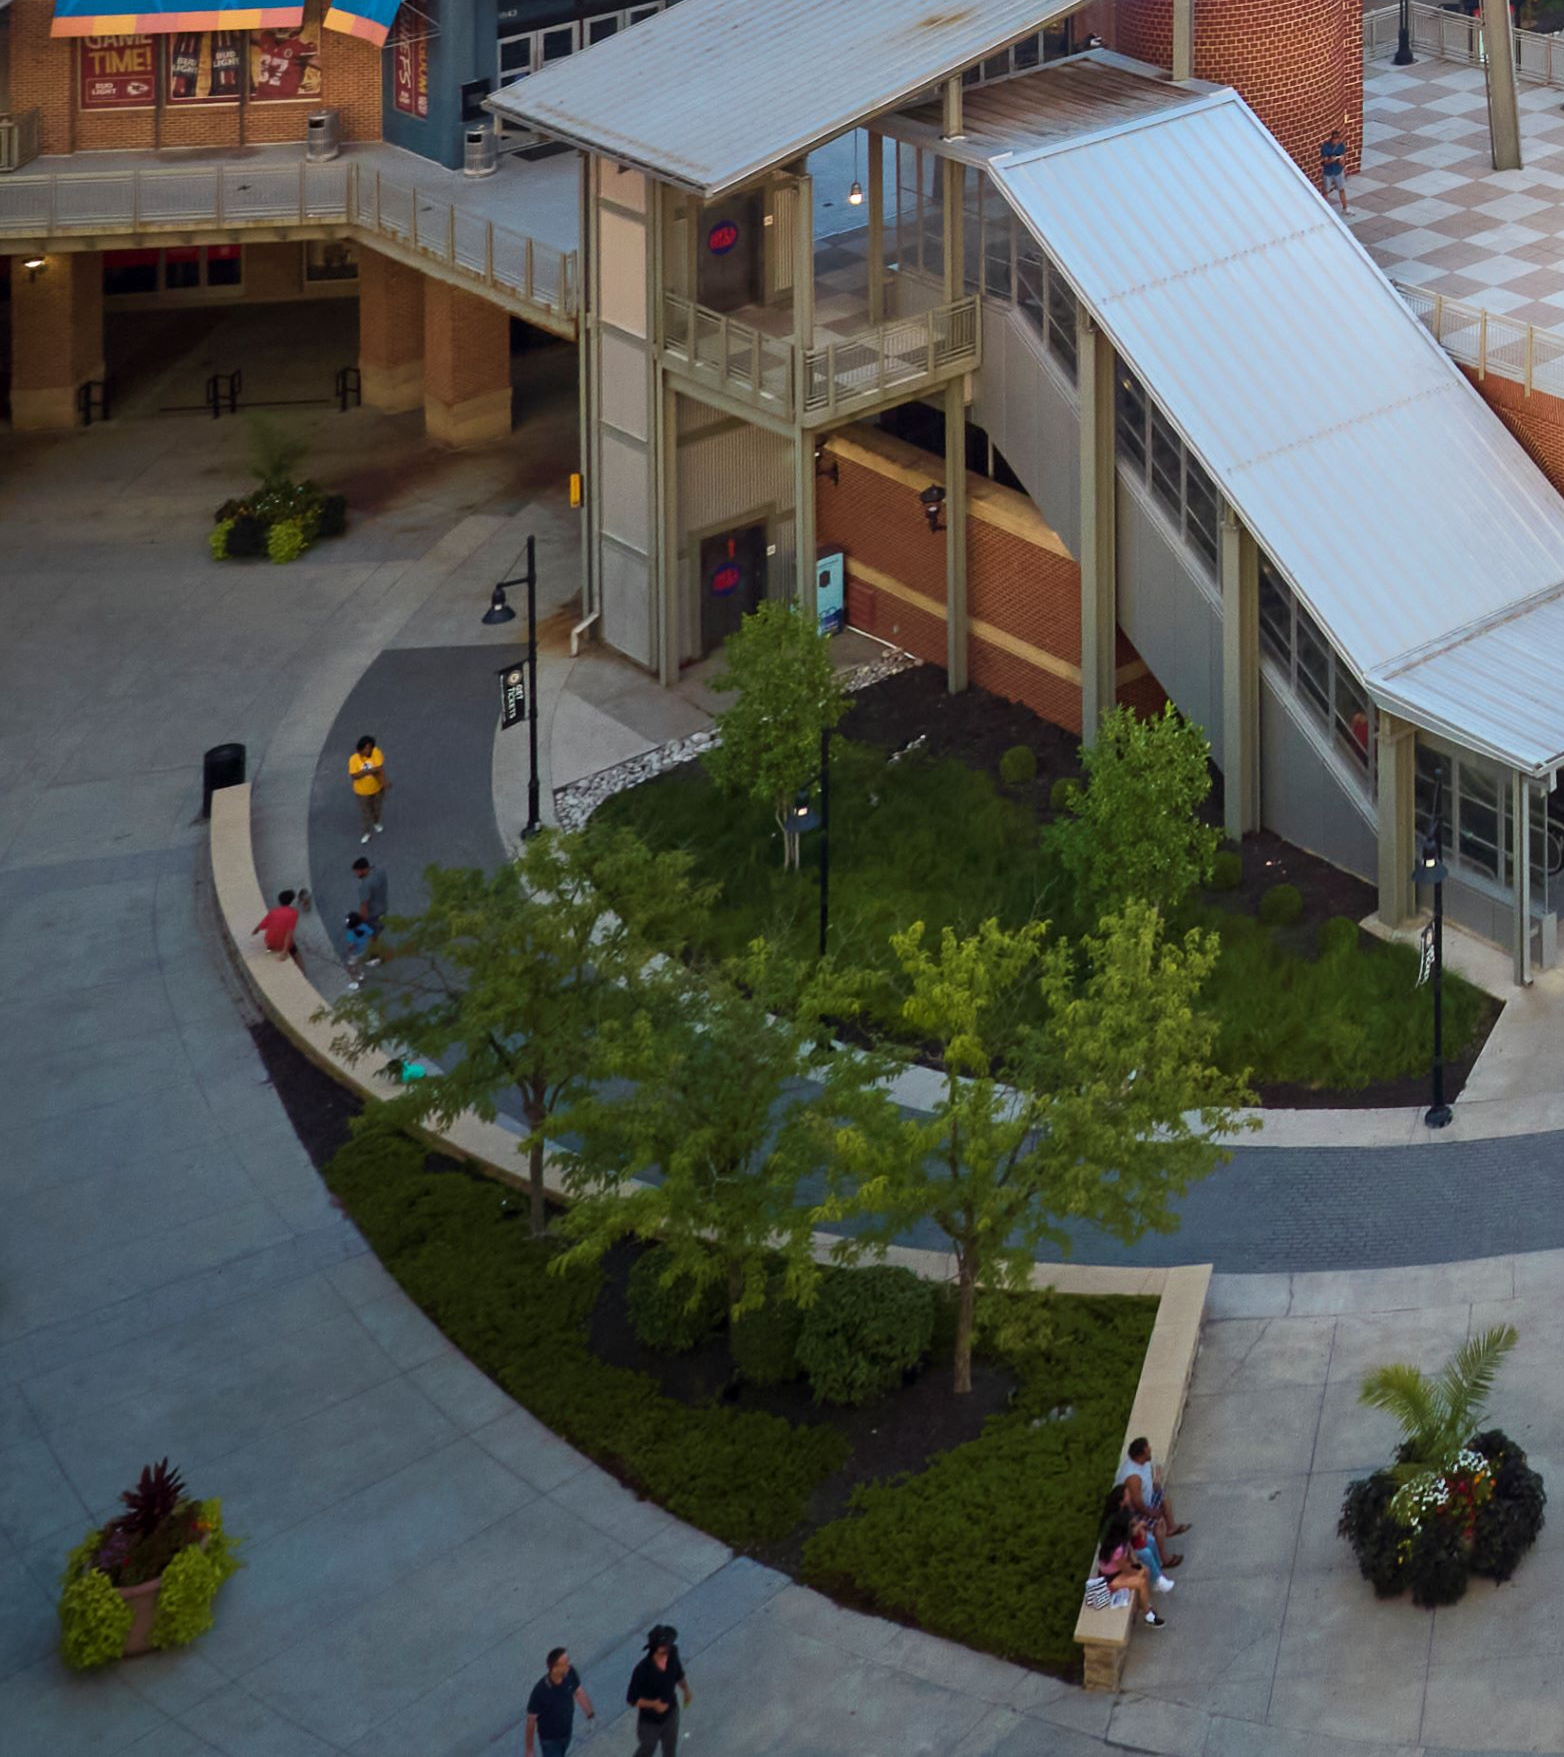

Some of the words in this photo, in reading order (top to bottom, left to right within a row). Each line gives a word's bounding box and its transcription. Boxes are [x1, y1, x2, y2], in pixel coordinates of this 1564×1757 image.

[215, 50, 236, 60] BUD
[88, 49, 152, 74] TIME!
[176, 56, 197, 66] BUD
[213, 57, 240, 68] LIGHT
[95, 82, 114, 90] BUD
[92, 88, 117, 96] LIGHT
[515, 683, 524, 700] GET
[507, 686, 517, 719] TICKETS
